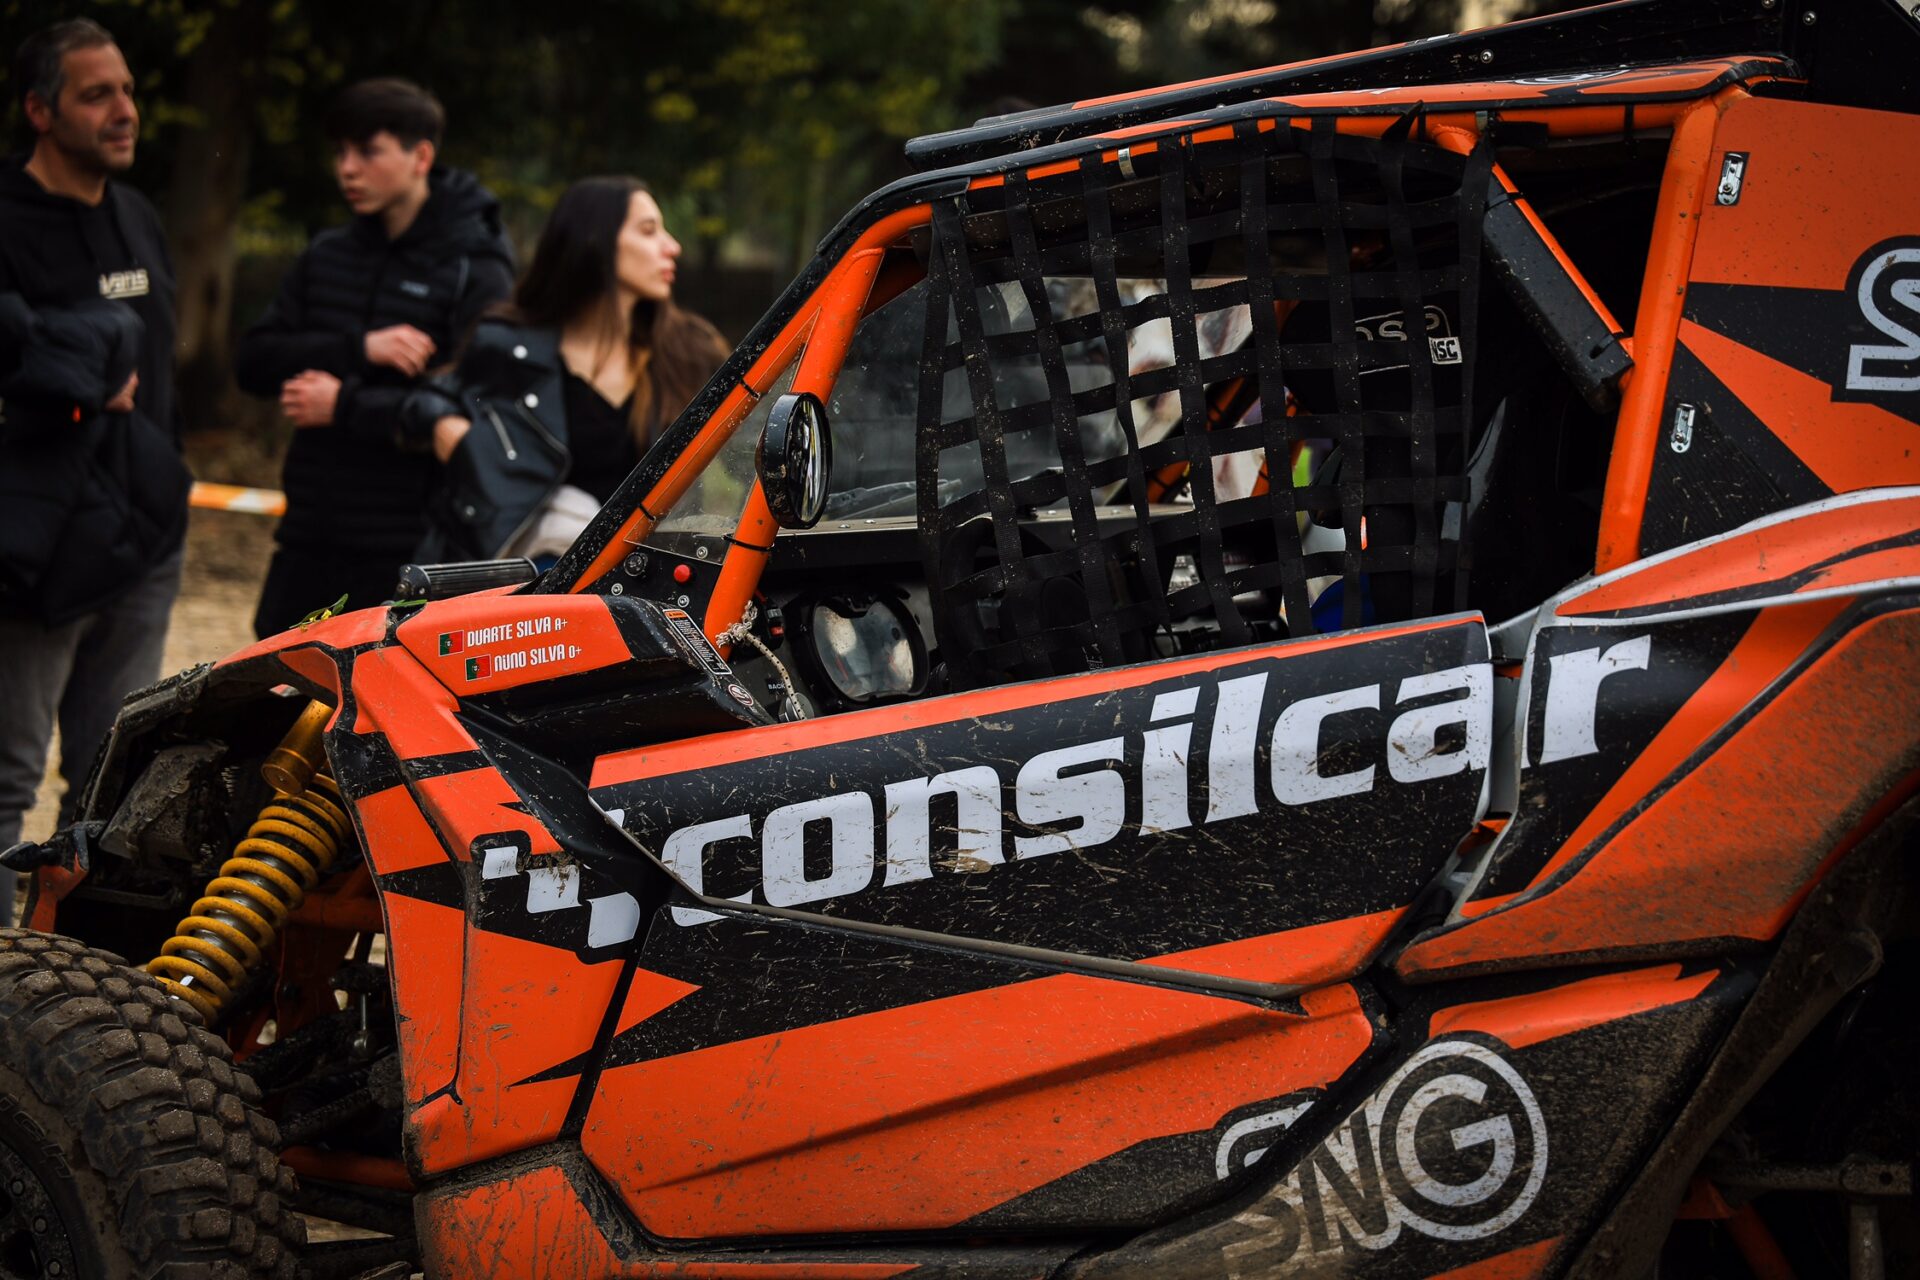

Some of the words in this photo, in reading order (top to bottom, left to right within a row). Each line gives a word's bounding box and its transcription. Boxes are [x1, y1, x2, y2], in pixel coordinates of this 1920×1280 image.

[467, 623, 513, 648] DUARTE
[516, 616, 552, 638] SILVA
[555, 618, 568, 631] A+
[530, 644, 565, 666] SILVA
[661, 635, 1652, 926] consilcar
